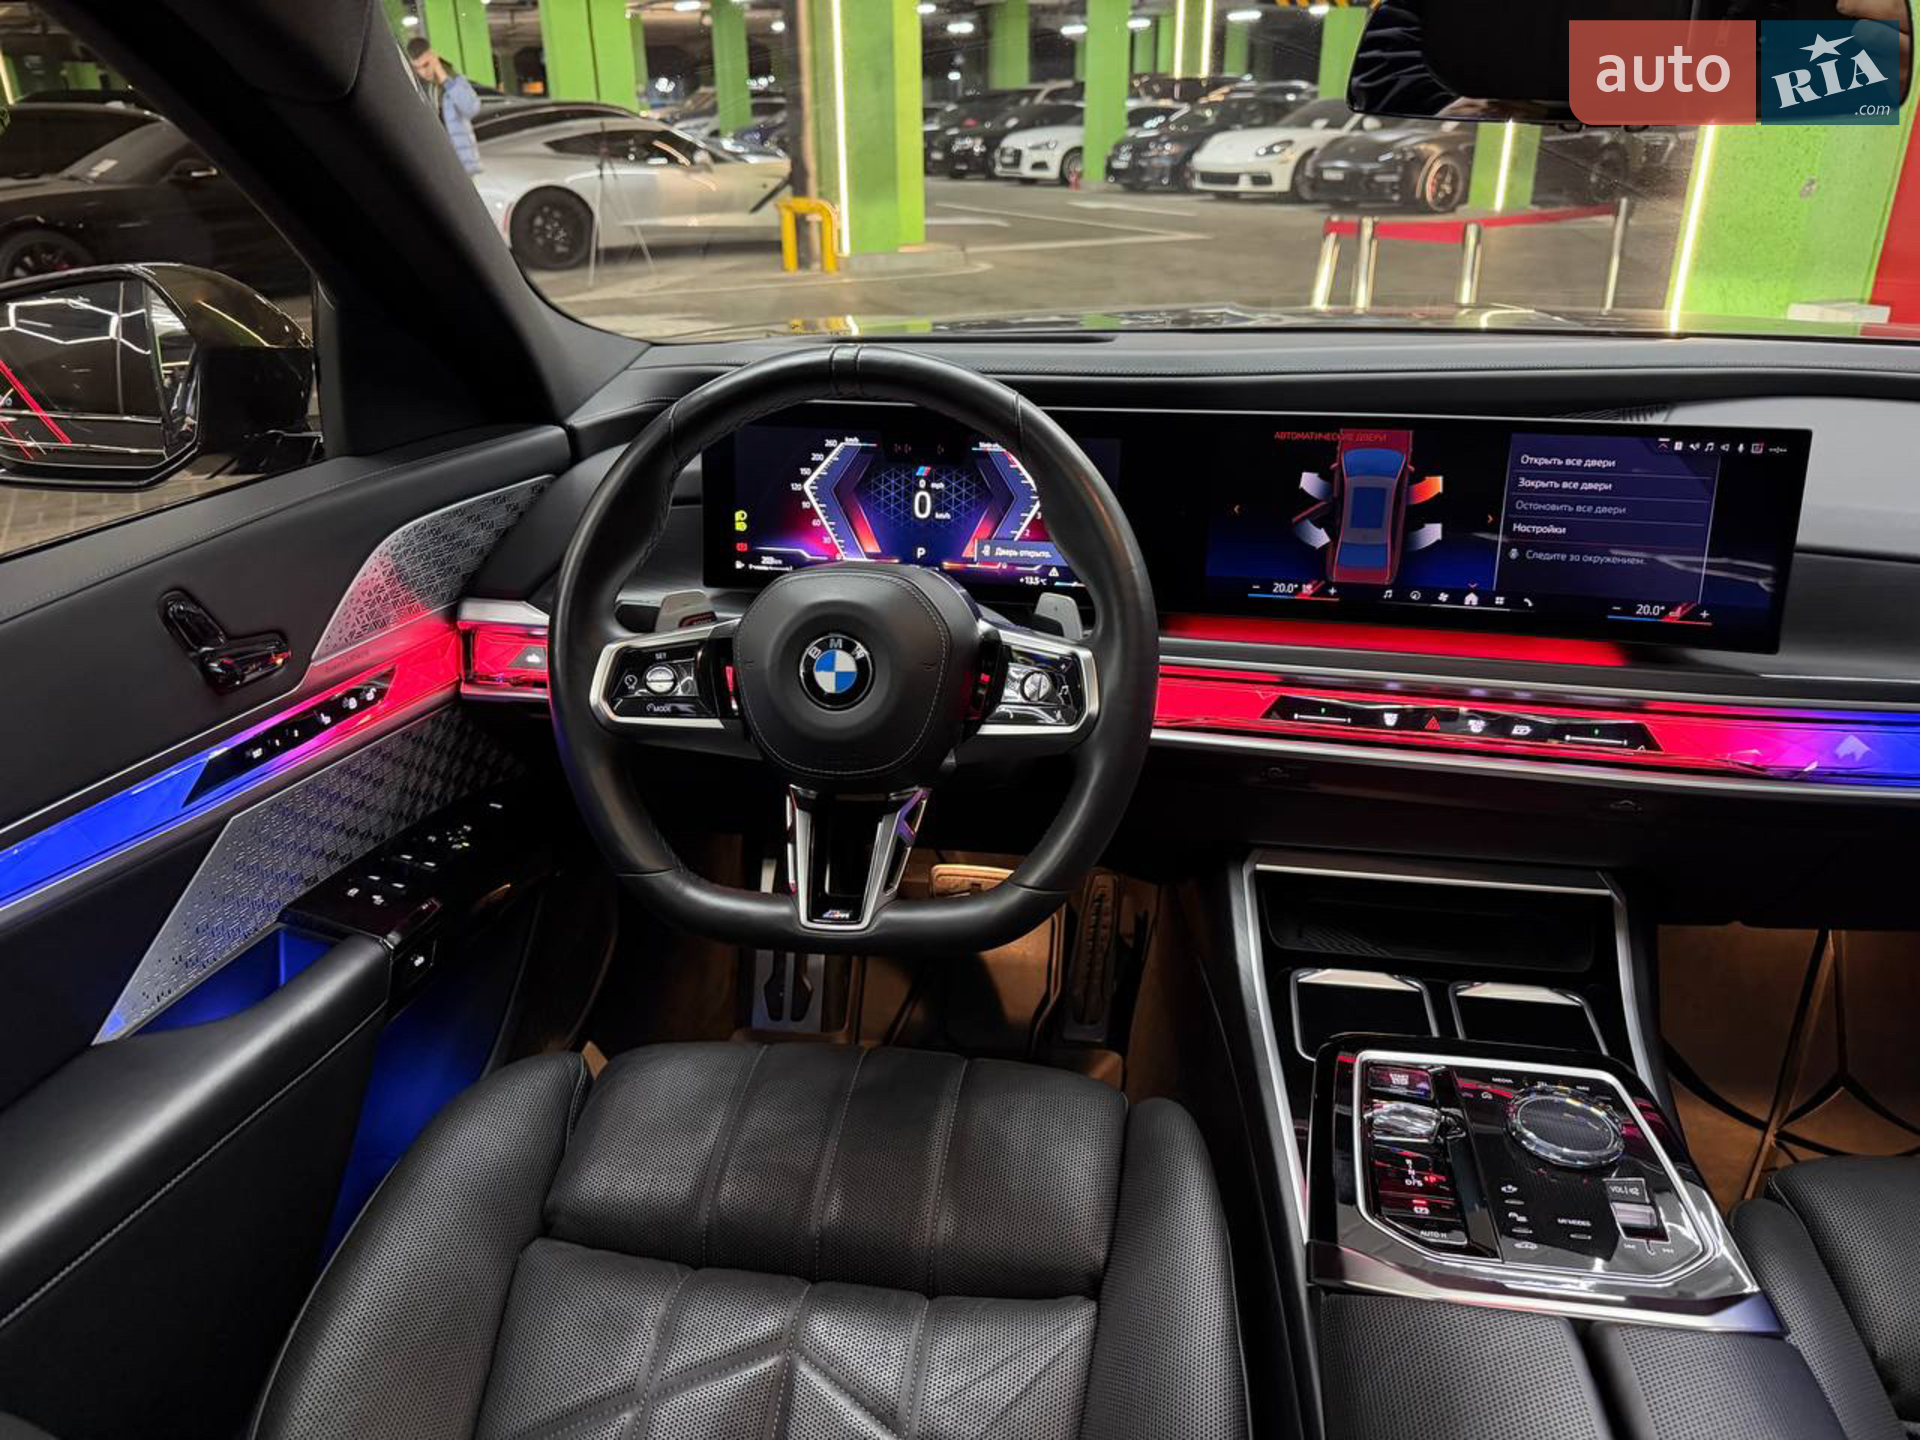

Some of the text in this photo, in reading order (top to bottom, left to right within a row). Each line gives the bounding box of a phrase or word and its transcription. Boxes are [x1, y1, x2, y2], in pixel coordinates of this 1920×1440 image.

[811, 453, 824, 461] 200
[1520, 454, 1616, 468] Открыть все двери
[790, 483, 802, 491] 120
[1518, 477, 1612, 491] Закрыть все двери
[914, 490, 932, 519] 0
[1515, 500, 1627, 515] Остановить все двери
[812, 519, 821, 527] 60
[1513, 522, 1567, 535] Настройки
[1025, 529, 1030, 537] 2
[917, 547, 926, 558] P
[1525, 550, 1567, 561] Следите
[808, 638, 865, 660] BMW
[1420, 1230, 1440, 1238] AUTO
